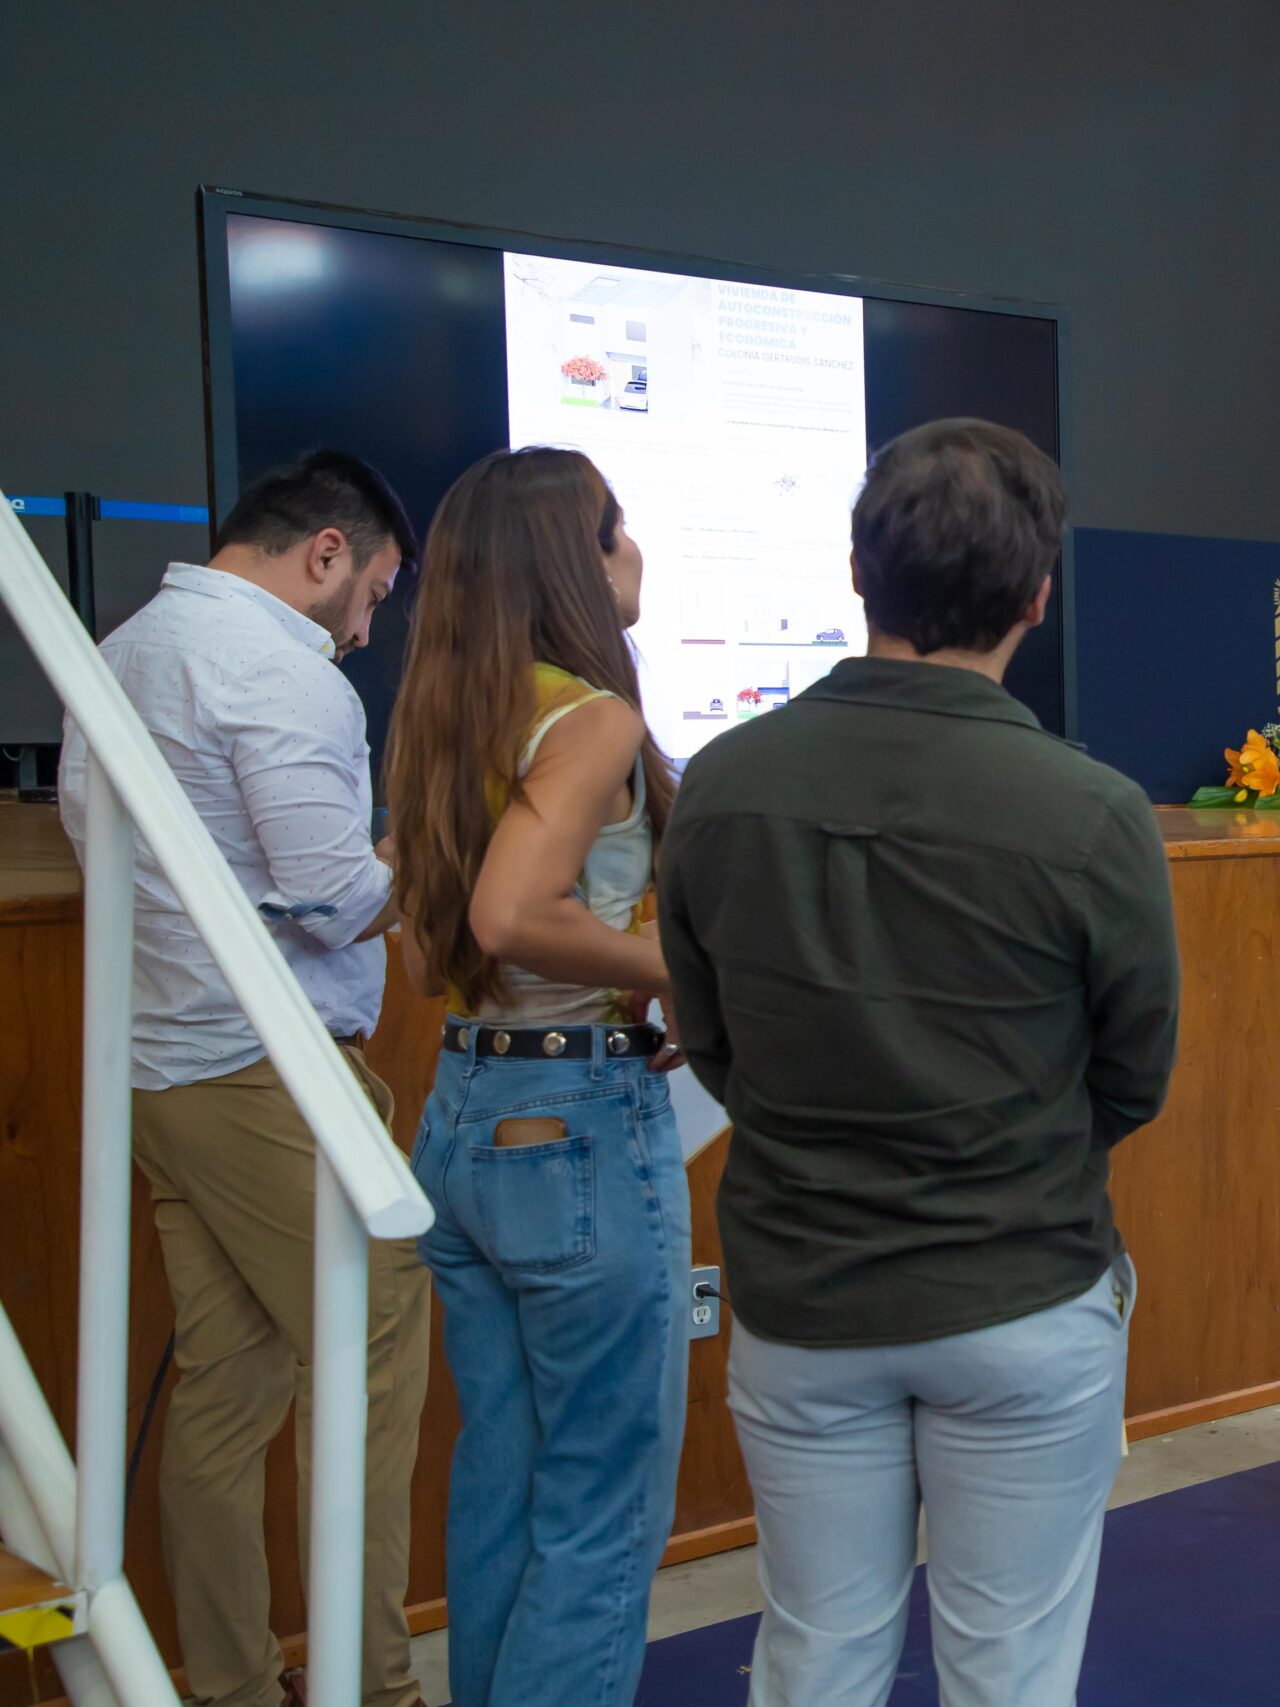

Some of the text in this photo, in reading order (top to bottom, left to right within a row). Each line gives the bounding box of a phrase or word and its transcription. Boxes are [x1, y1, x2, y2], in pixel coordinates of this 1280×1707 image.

[718, 284, 797, 304] VIVIENDA DE
[718, 299, 853, 326] AUTOCONSTRUCCIÓN
[718, 315, 808, 337] PROGRESIVA Y
[718, 347, 760, 362] COLONIA
[762, 351, 812, 367] GERTRUDIS
